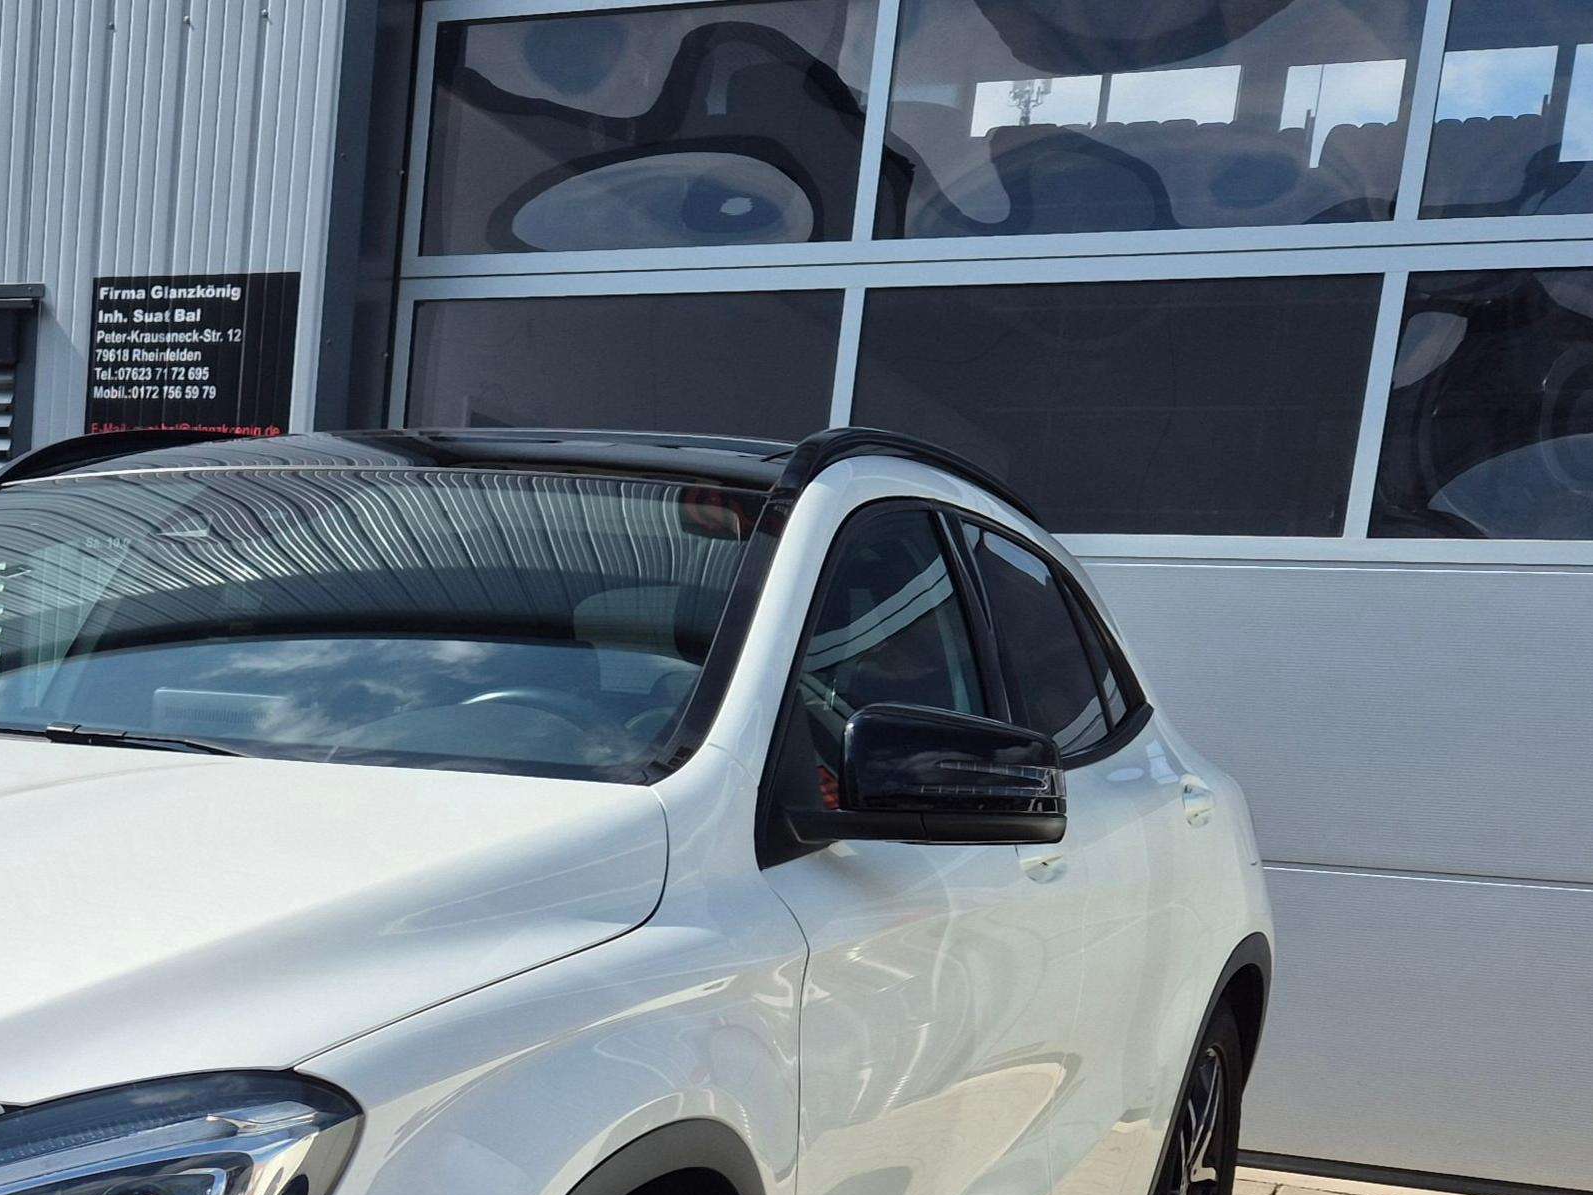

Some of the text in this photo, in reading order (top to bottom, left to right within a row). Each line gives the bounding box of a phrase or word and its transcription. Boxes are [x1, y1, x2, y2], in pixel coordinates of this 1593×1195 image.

[99, 284, 242, 301] Firma Glanzkönig
[98, 308, 202, 324] Inh. Suat Bal
[227, 328, 242, 342] 12
[95, 348, 202, 362] 79618 Rheinfelden
[155, 367, 168, 380] 71
[171, 367, 186, 380] 72
[188, 366, 210, 380] 695
[184, 386, 199, 399] 59
[202, 385, 217, 399] 79
